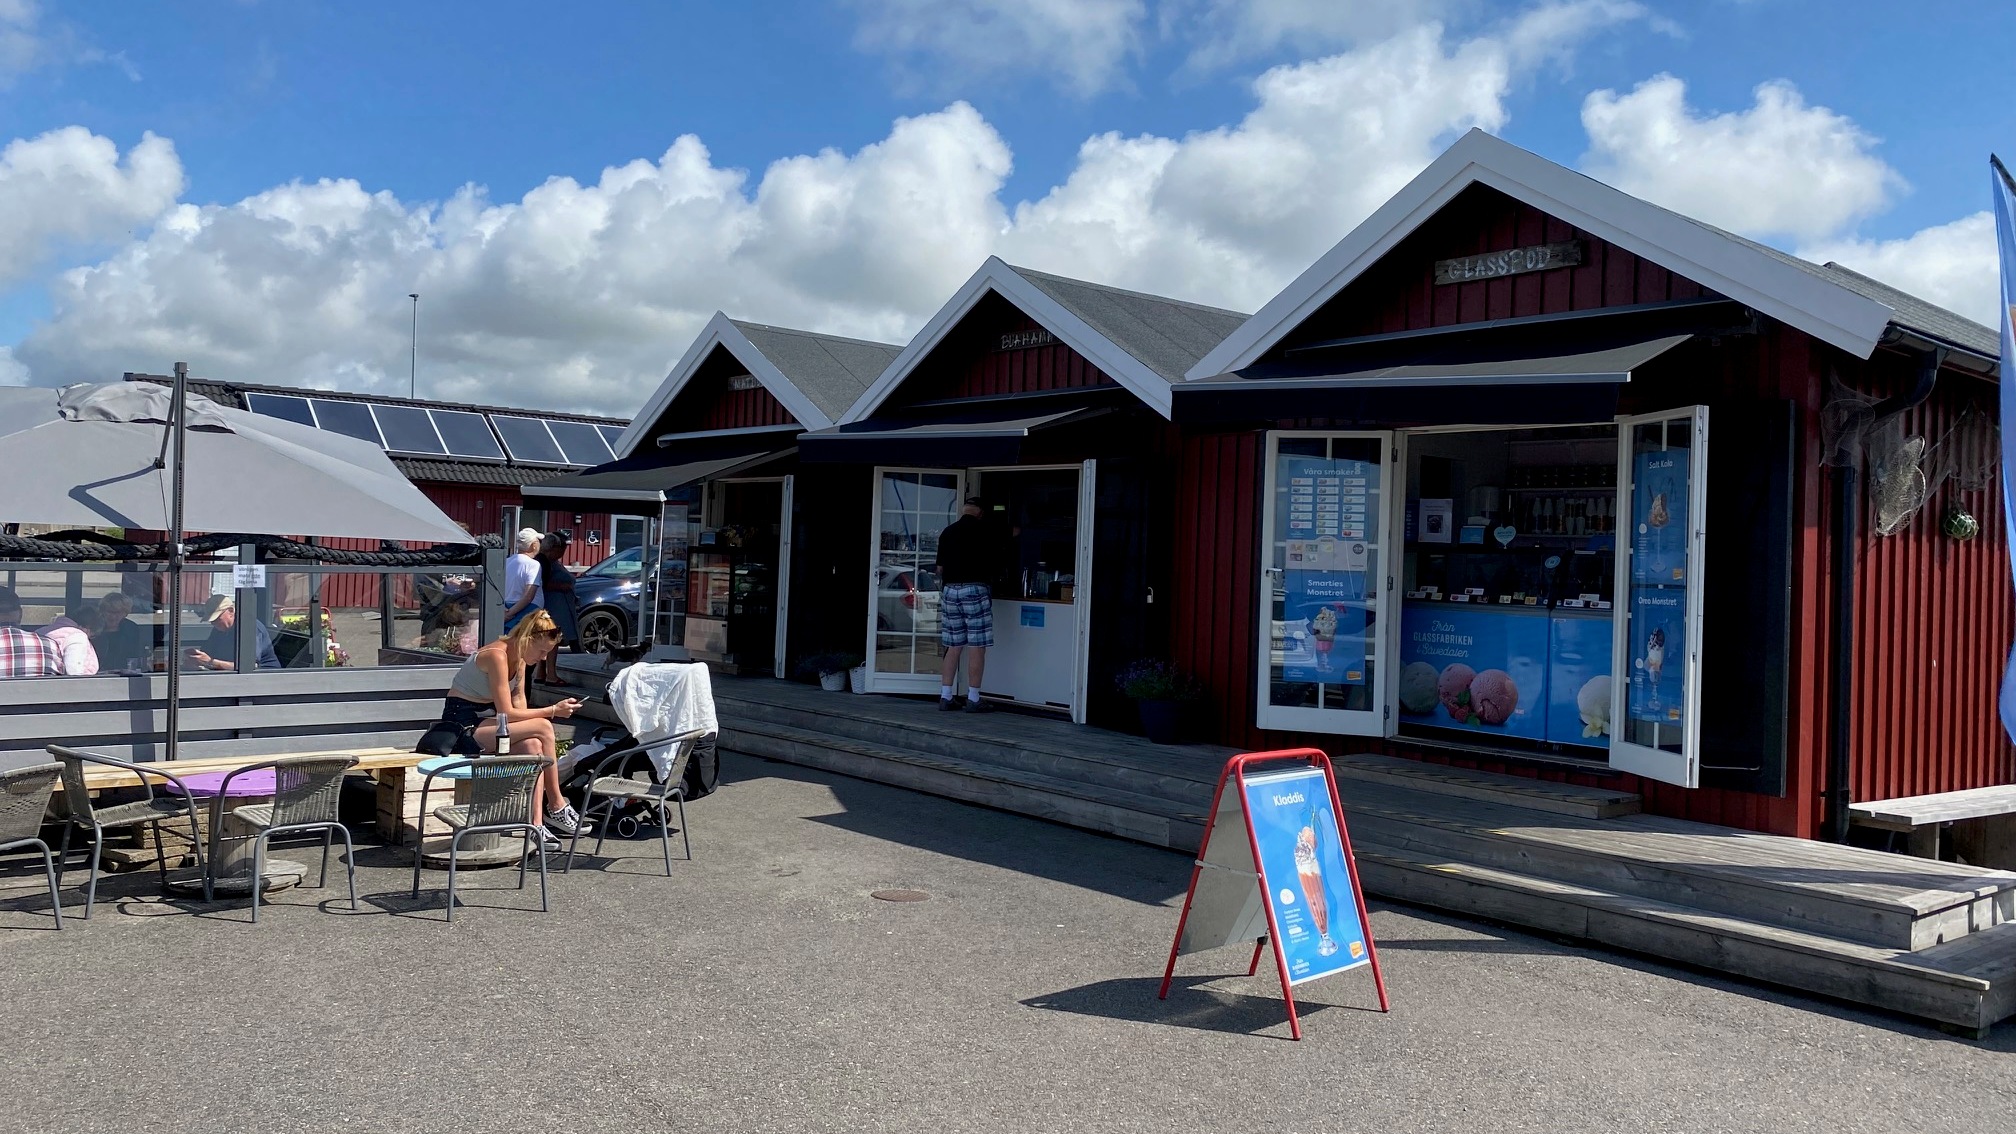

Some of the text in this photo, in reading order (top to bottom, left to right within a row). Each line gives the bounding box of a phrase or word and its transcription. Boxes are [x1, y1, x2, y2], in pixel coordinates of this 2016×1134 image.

[1303, 466, 1355, 476] Våra smaker
[1307, 579, 1344, 588] Smarties
[1306, 588, 1345, 597] Monstret
[1638, 596, 1677, 606] Oreo Monstret
[1431, 619, 1456, 632] Från
[1413, 632, 1473, 646] GLASSFABRIKEN
[1272, 791, 1305, 806] Kladdis
